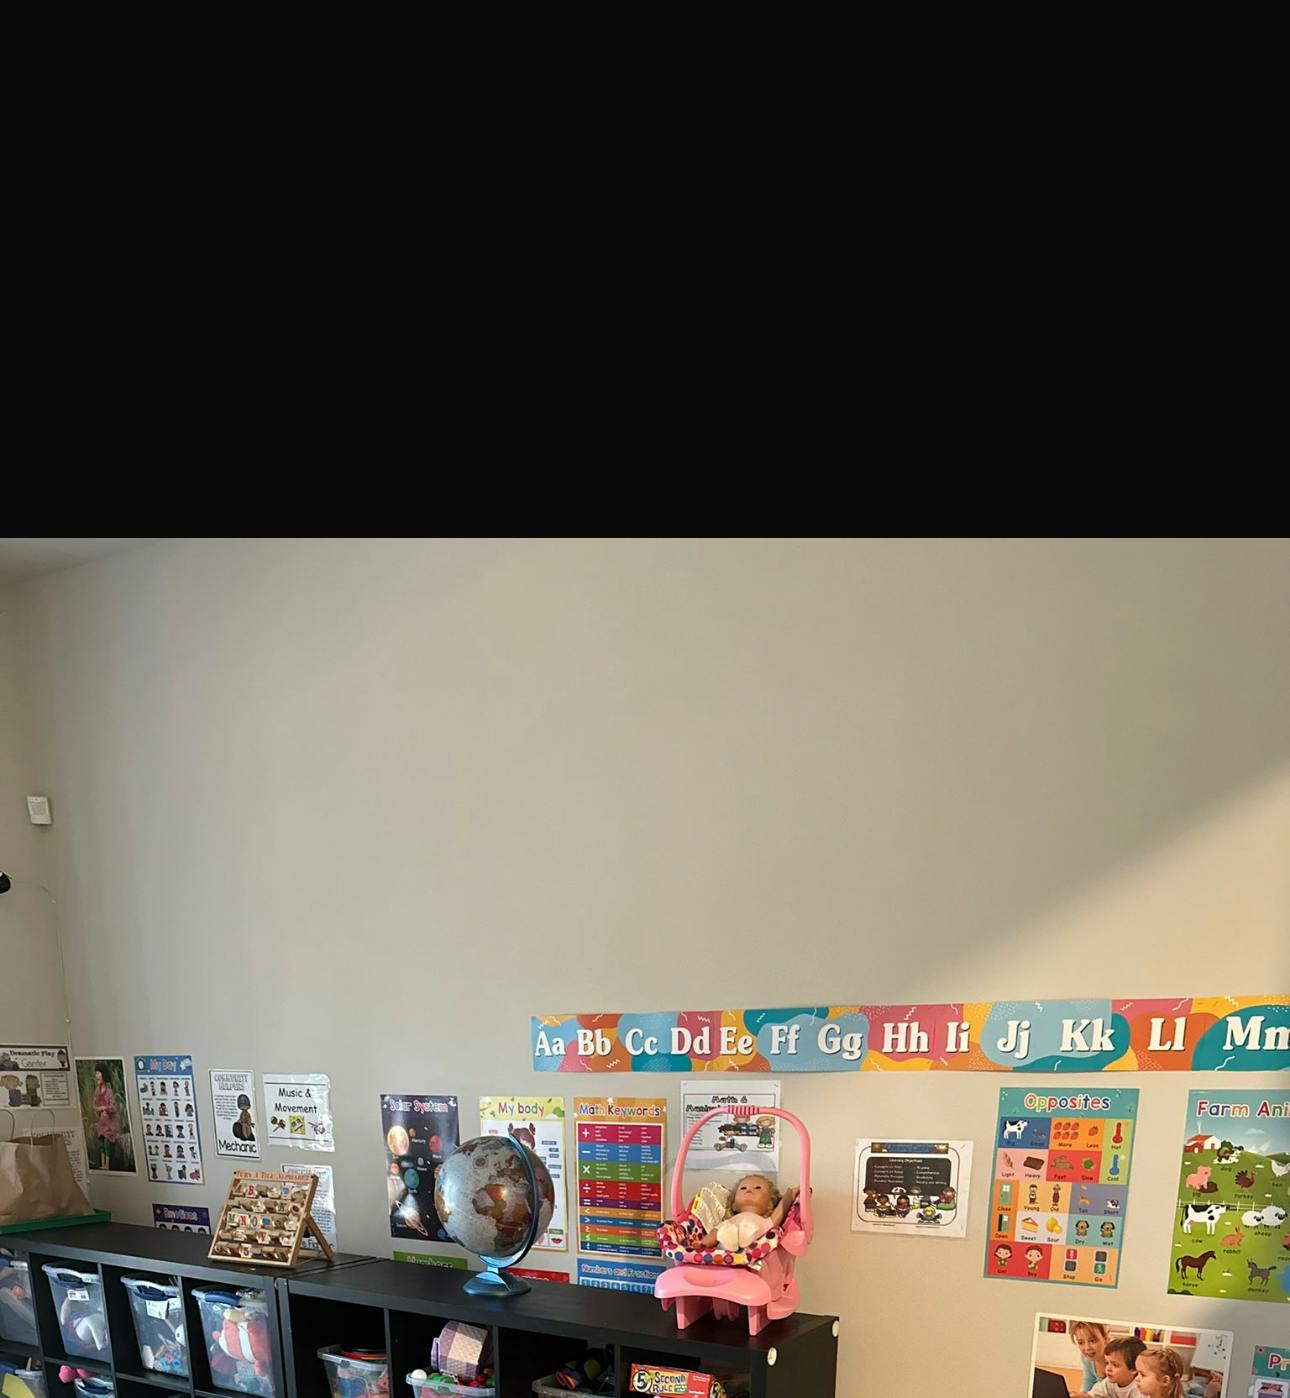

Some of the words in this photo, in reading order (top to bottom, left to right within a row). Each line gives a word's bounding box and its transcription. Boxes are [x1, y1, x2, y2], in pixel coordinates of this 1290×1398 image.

[535, 1031, 566, 1056] Aa
[577, 1029, 611, 1056] Bb
[625, 1028, 658, 1056] Cc
[671, 1026, 711, 1055] Dd
[720, 1027, 753, 1055] Ee
[770, 1026, 800, 1054] Ff
[817, 1024, 864, 1060] Gg
[882, 1022, 930, 1053] Hh
[946, 1022, 971, 1053] Ii
[997, 1020, 1032, 1059] Jj
[1060, 1018, 1116, 1051] Kk
[1148, 1017, 1187, 1051] Ll
[278, 1088, 303, 1098] Music
[305, 1089, 312, 1097] &
[275, 1103, 317, 1114] Movement
[389, 1100, 413, 1112] Solar
[413, 1101, 449, 1114] System
[1024, 1093, 1111, 1111] Opposites
[1197, 1101, 1249, 1116] Farm
[1257, 1101, 1290, 1116] Ani
[498, 1102, 515, 1116] My
[518, 1102, 545, 1117] body
[580, 1104, 605, 1115] Math
[607, 1104, 660, 1117] Keywords
[218, 1139, 257, 1153] Mechanic
[1002, 1172, 1015, 1180] Light
[637, 1373, 648, 1390] 5
[654, 1372, 686, 1385] SECOND
[652, 1384, 673, 1394] RULE
